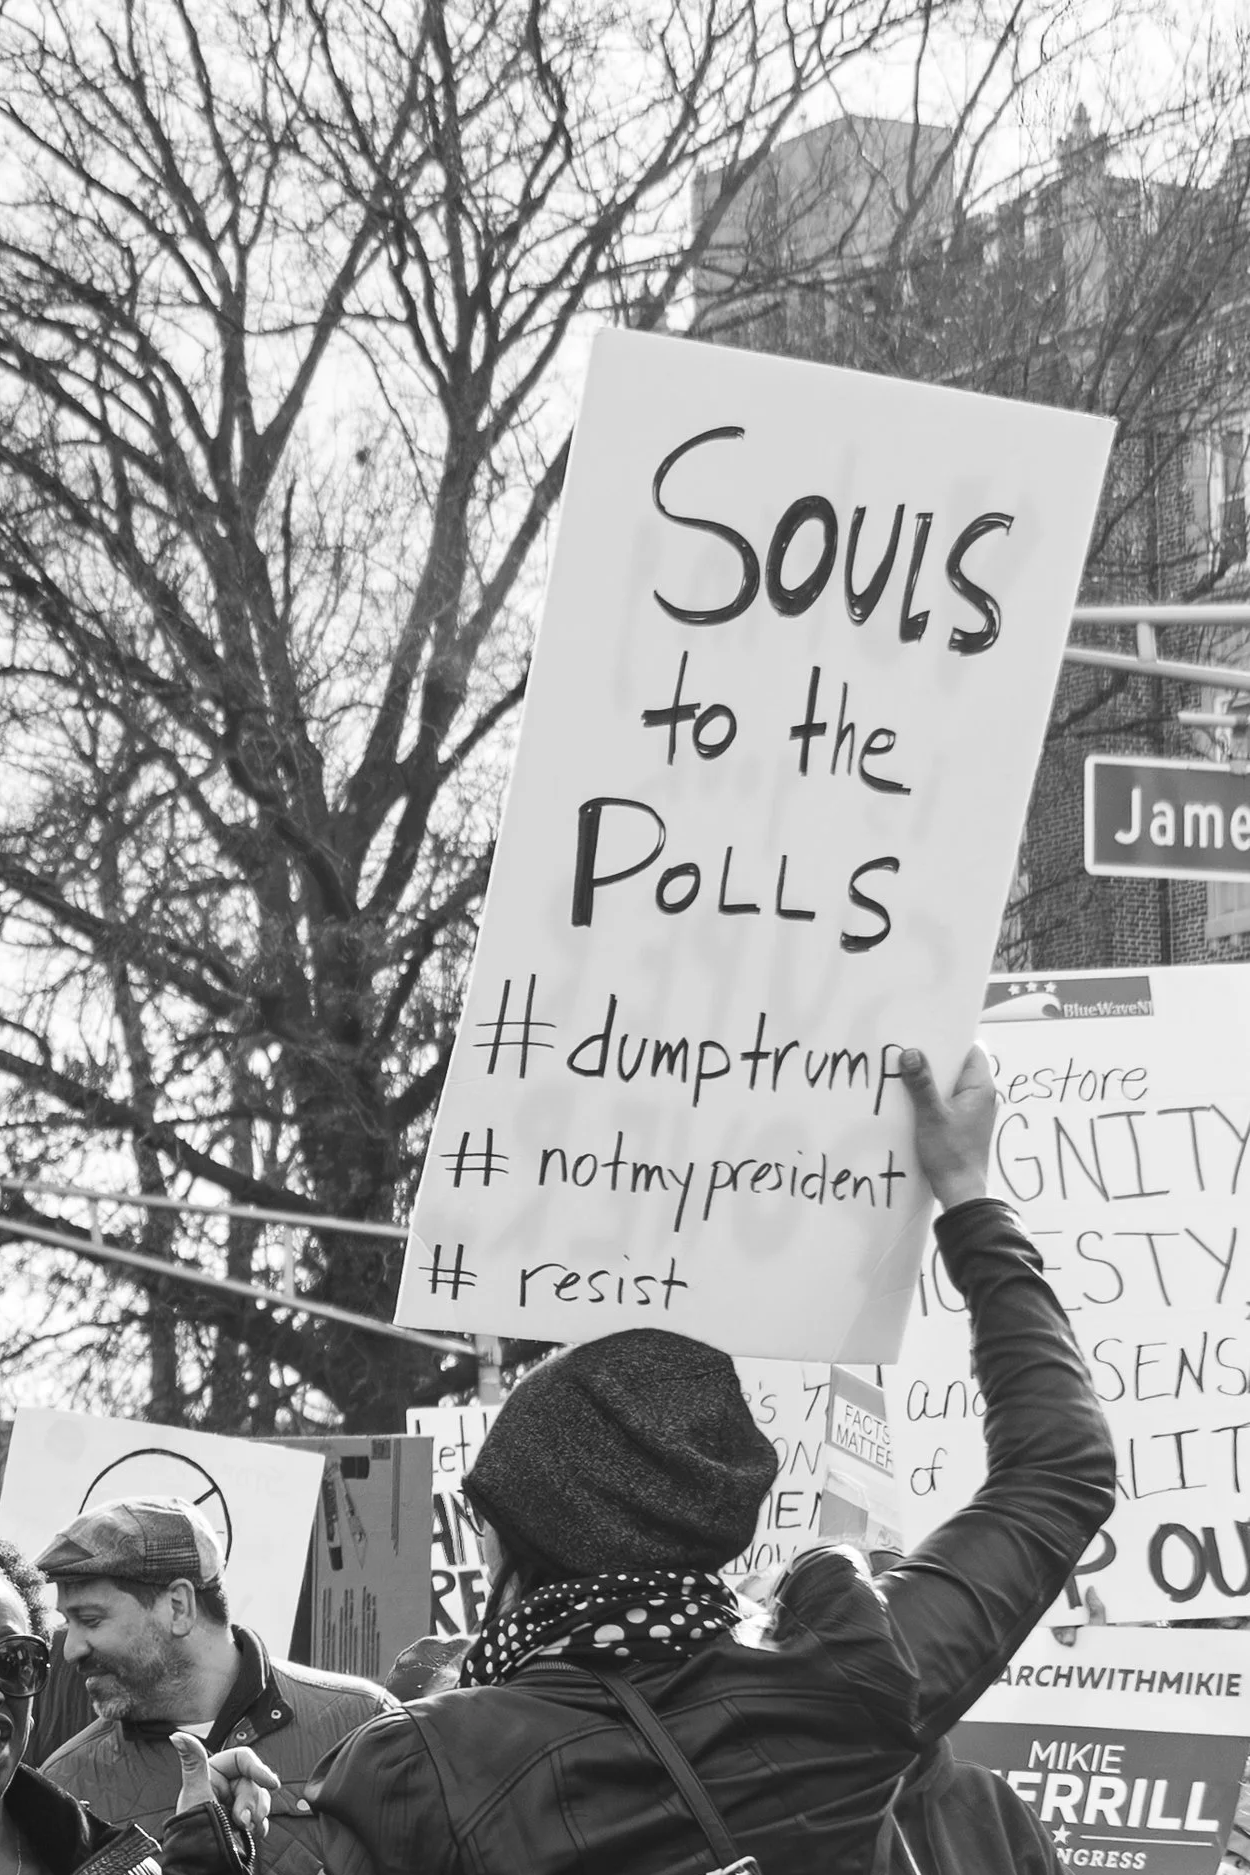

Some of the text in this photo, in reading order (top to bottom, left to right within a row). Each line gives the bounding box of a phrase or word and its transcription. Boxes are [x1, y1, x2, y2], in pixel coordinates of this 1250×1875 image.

[642, 651, 911, 795] to the
[519, 1254, 689, 1310] resist
[1028, 1740, 1127, 1775] MIKIE
[990, 1769, 1220, 1833] ERRILL
